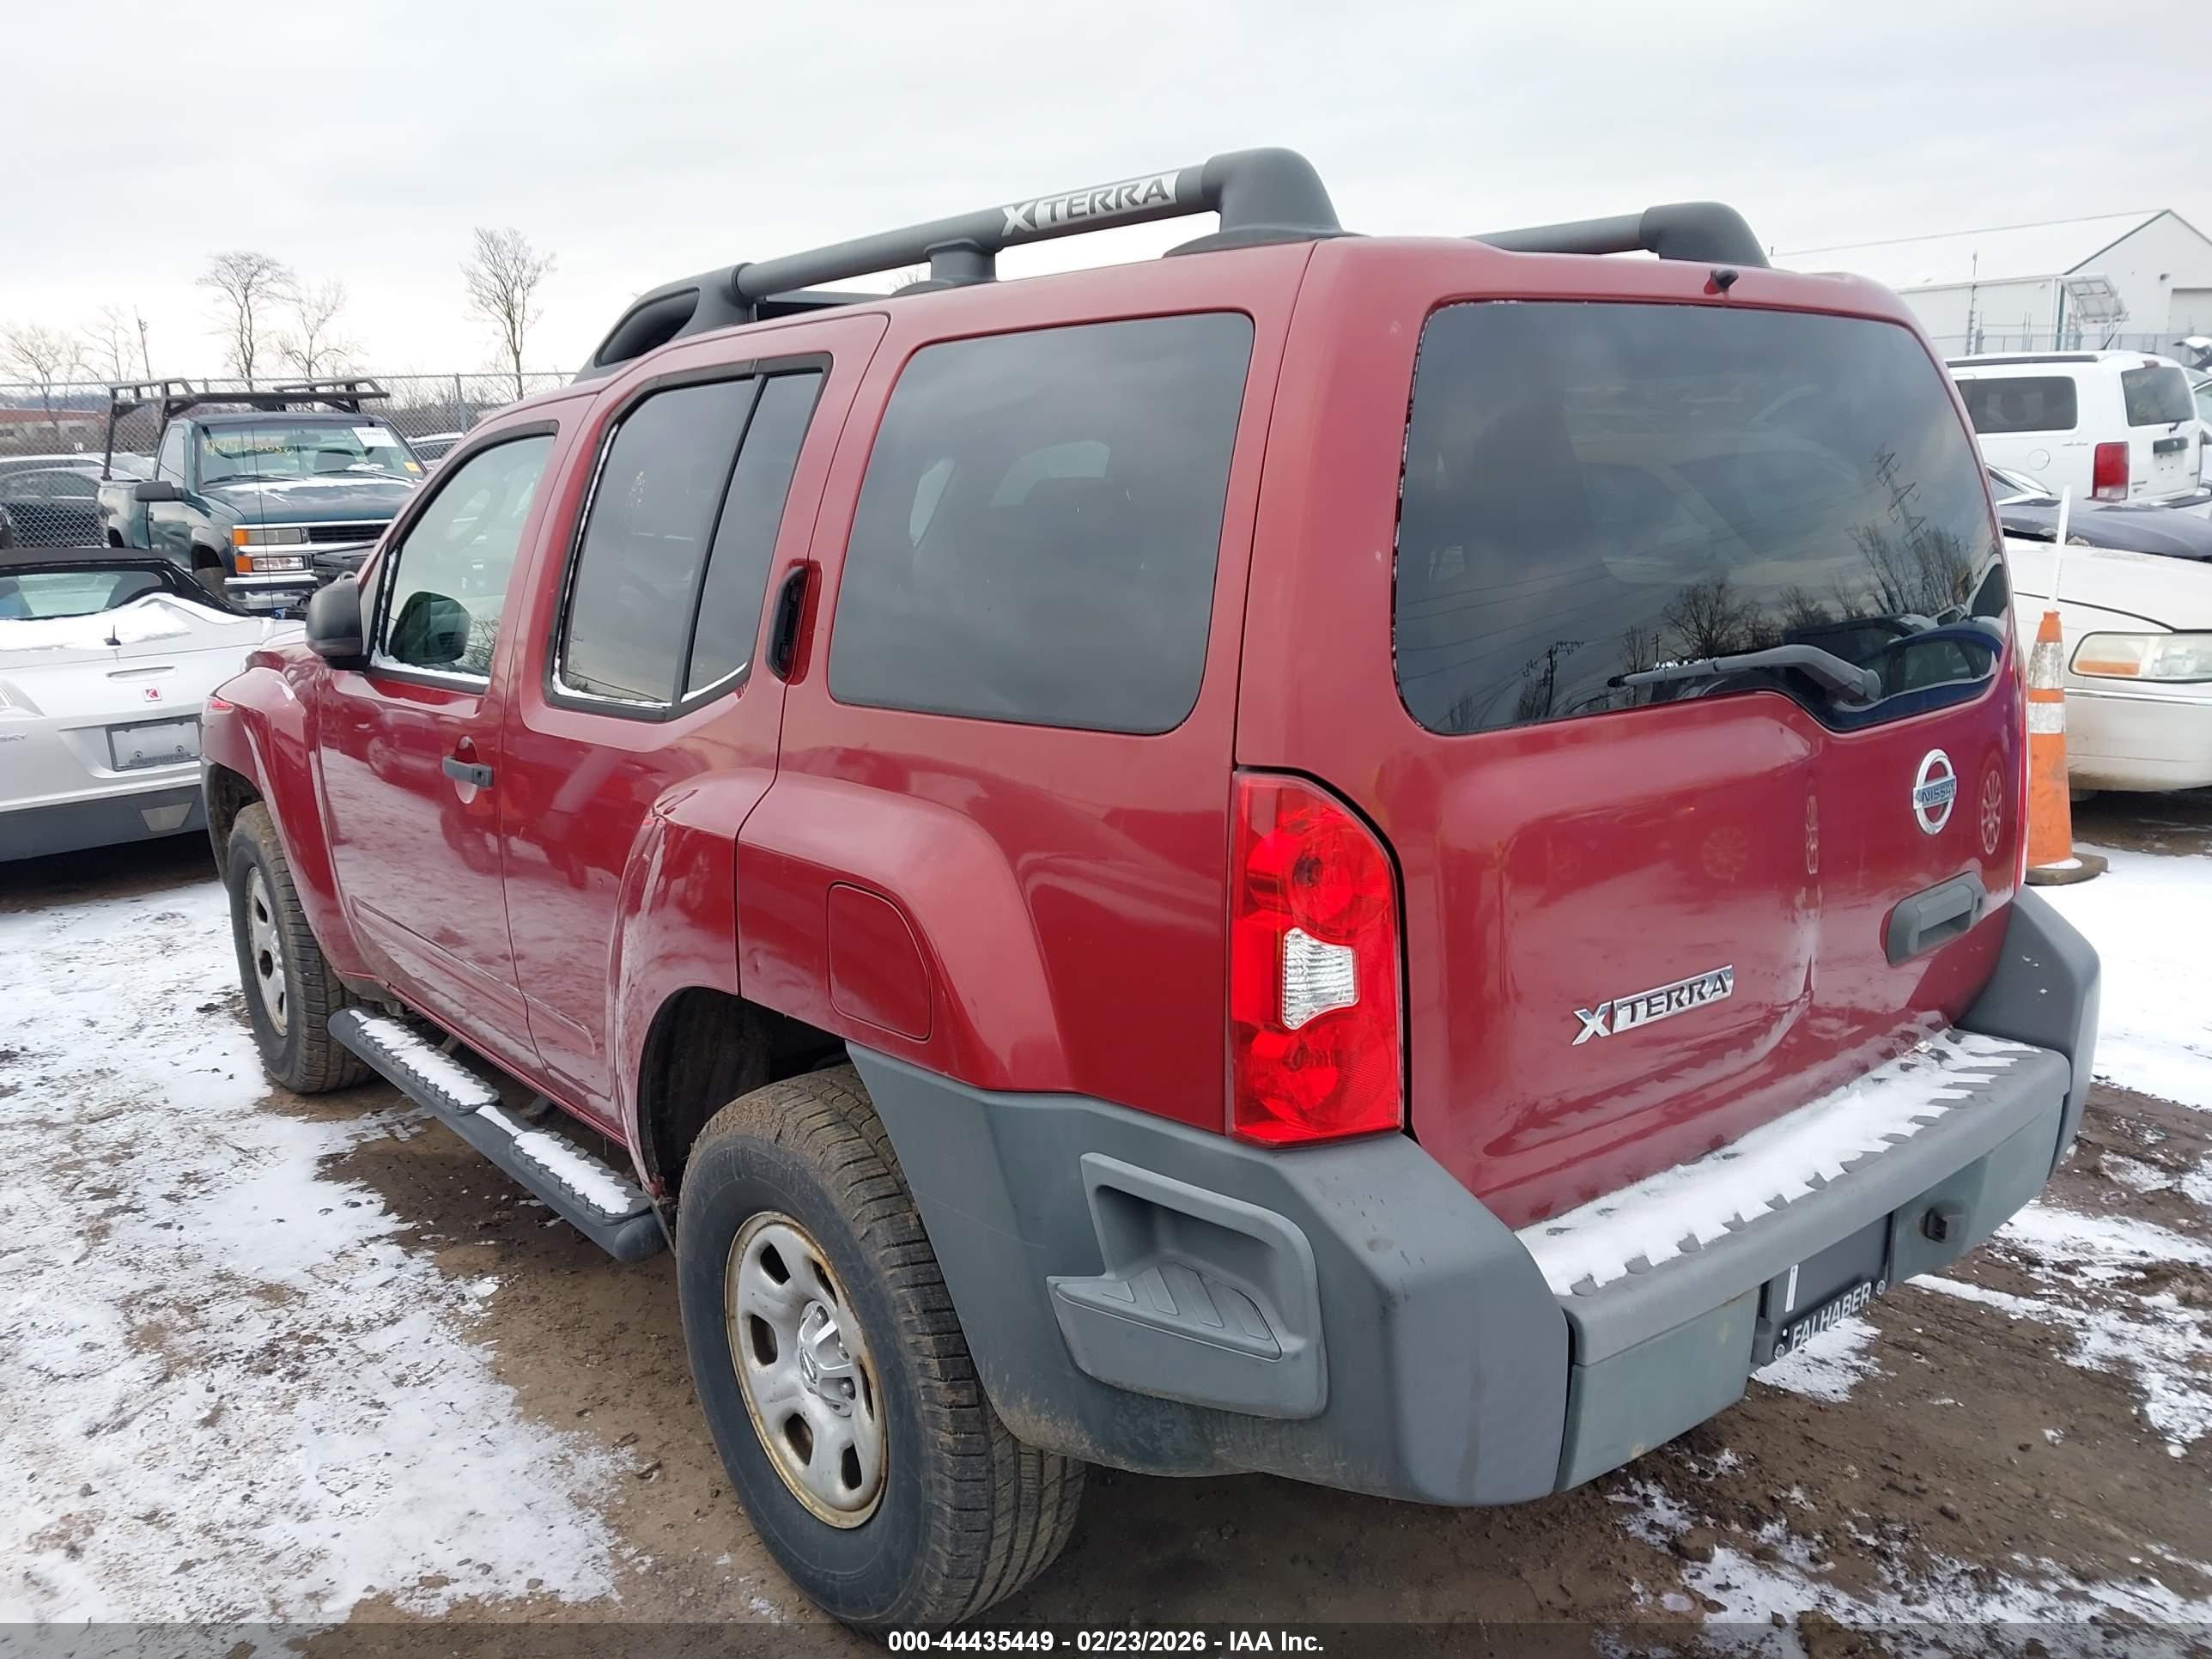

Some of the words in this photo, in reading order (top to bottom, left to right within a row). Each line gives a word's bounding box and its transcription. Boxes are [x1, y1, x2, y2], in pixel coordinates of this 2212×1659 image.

[1001, 173, 1178, 237] XTERRA
[1571, 964, 1734, 1046] XTERRA
[1791, 1280, 1873, 1351] FALHABER
